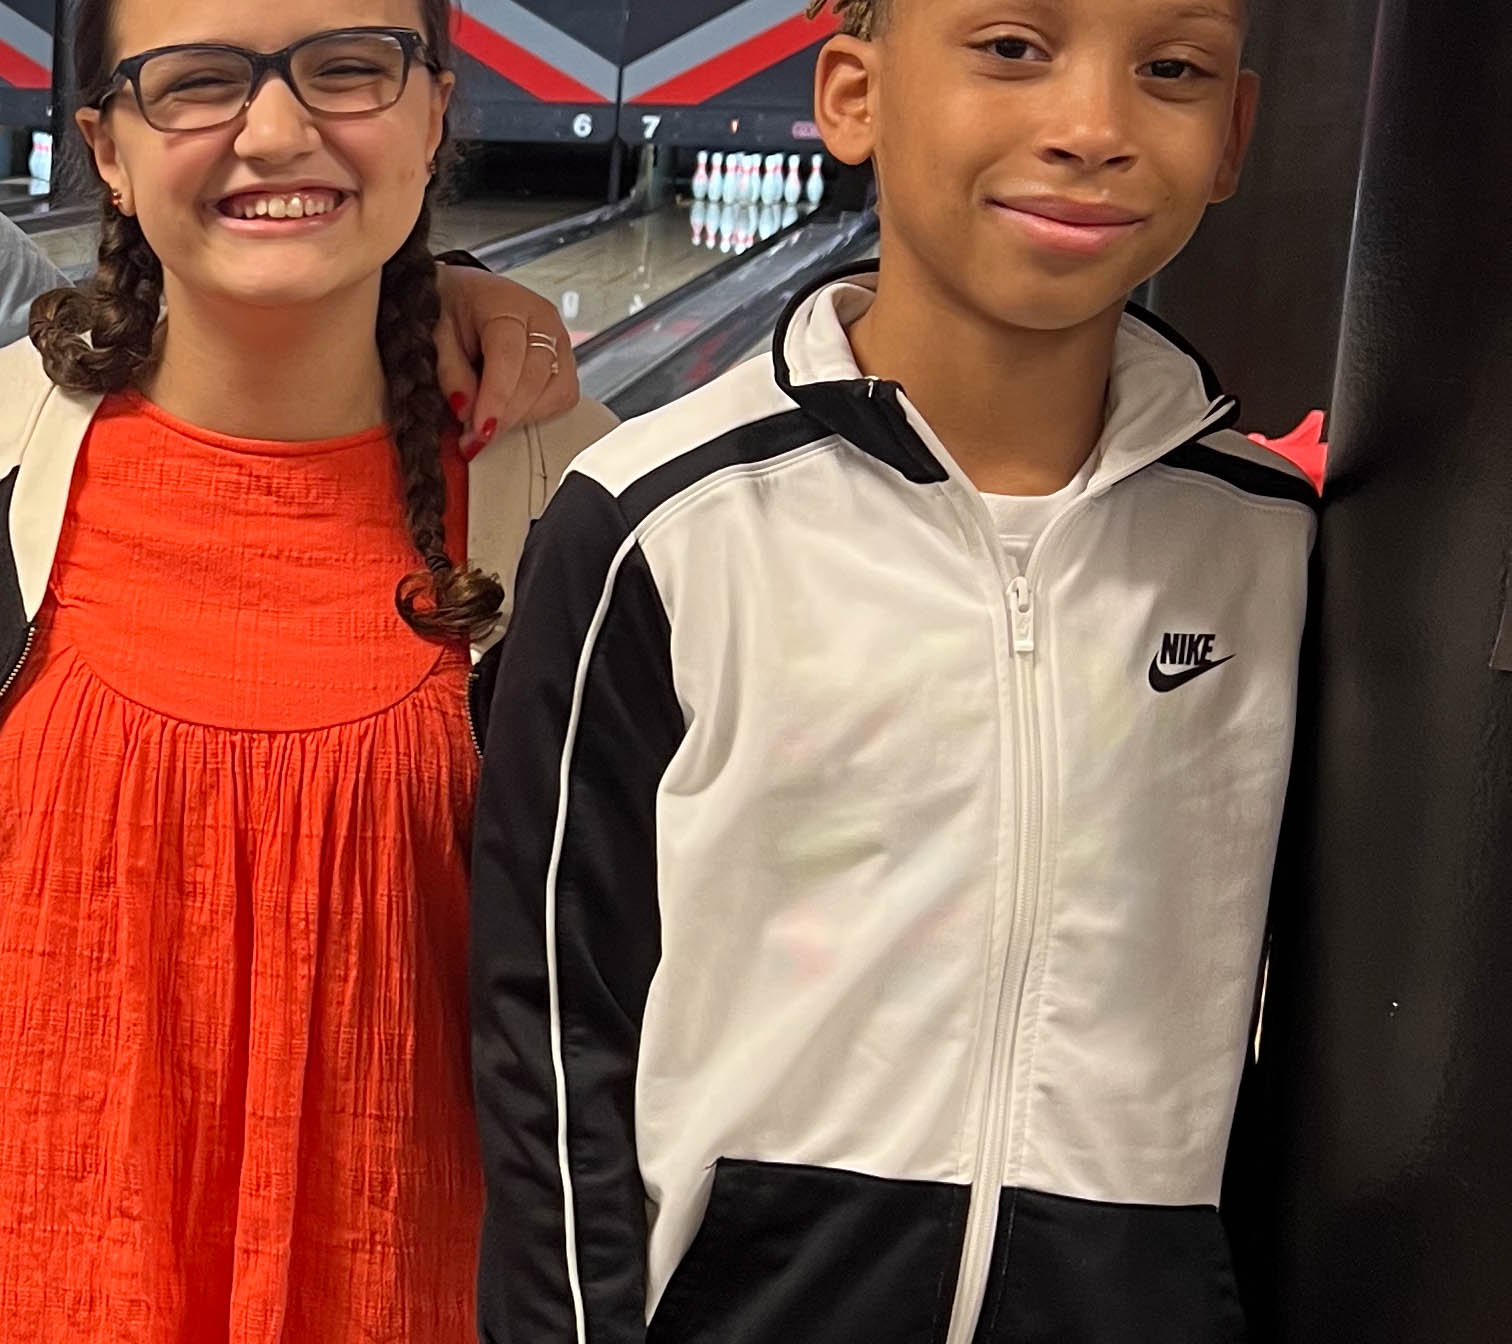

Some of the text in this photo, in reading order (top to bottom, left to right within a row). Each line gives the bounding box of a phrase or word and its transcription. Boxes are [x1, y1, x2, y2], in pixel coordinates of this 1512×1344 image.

[573, 113, 593, 138] 6
[641, 115, 662, 139] 7
[1160, 632, 1216, 666] NIKE
